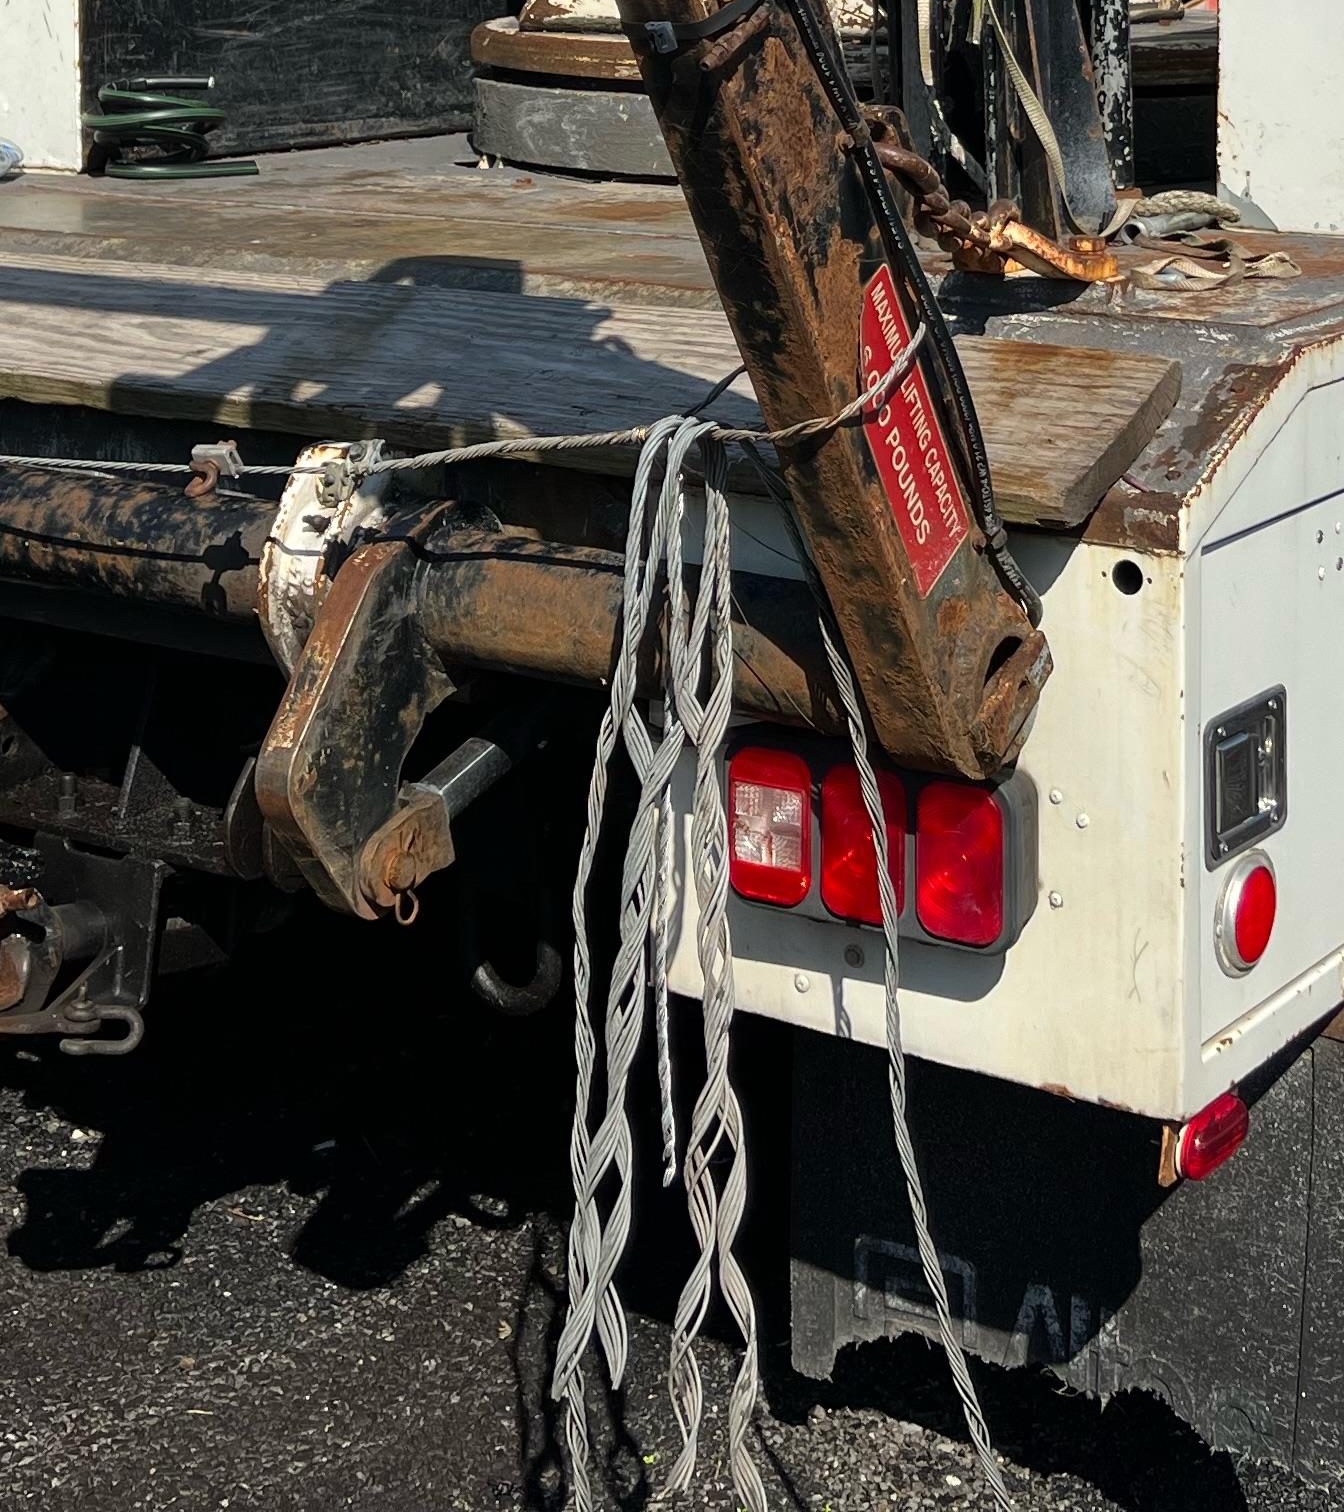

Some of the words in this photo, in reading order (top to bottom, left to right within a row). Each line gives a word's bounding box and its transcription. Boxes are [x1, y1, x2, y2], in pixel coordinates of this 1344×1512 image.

[884, 424, 933, 548] POUNDS
[901, 382, 929, 452] LIFTING
[923, 445, 964, 542] CAPACITY
